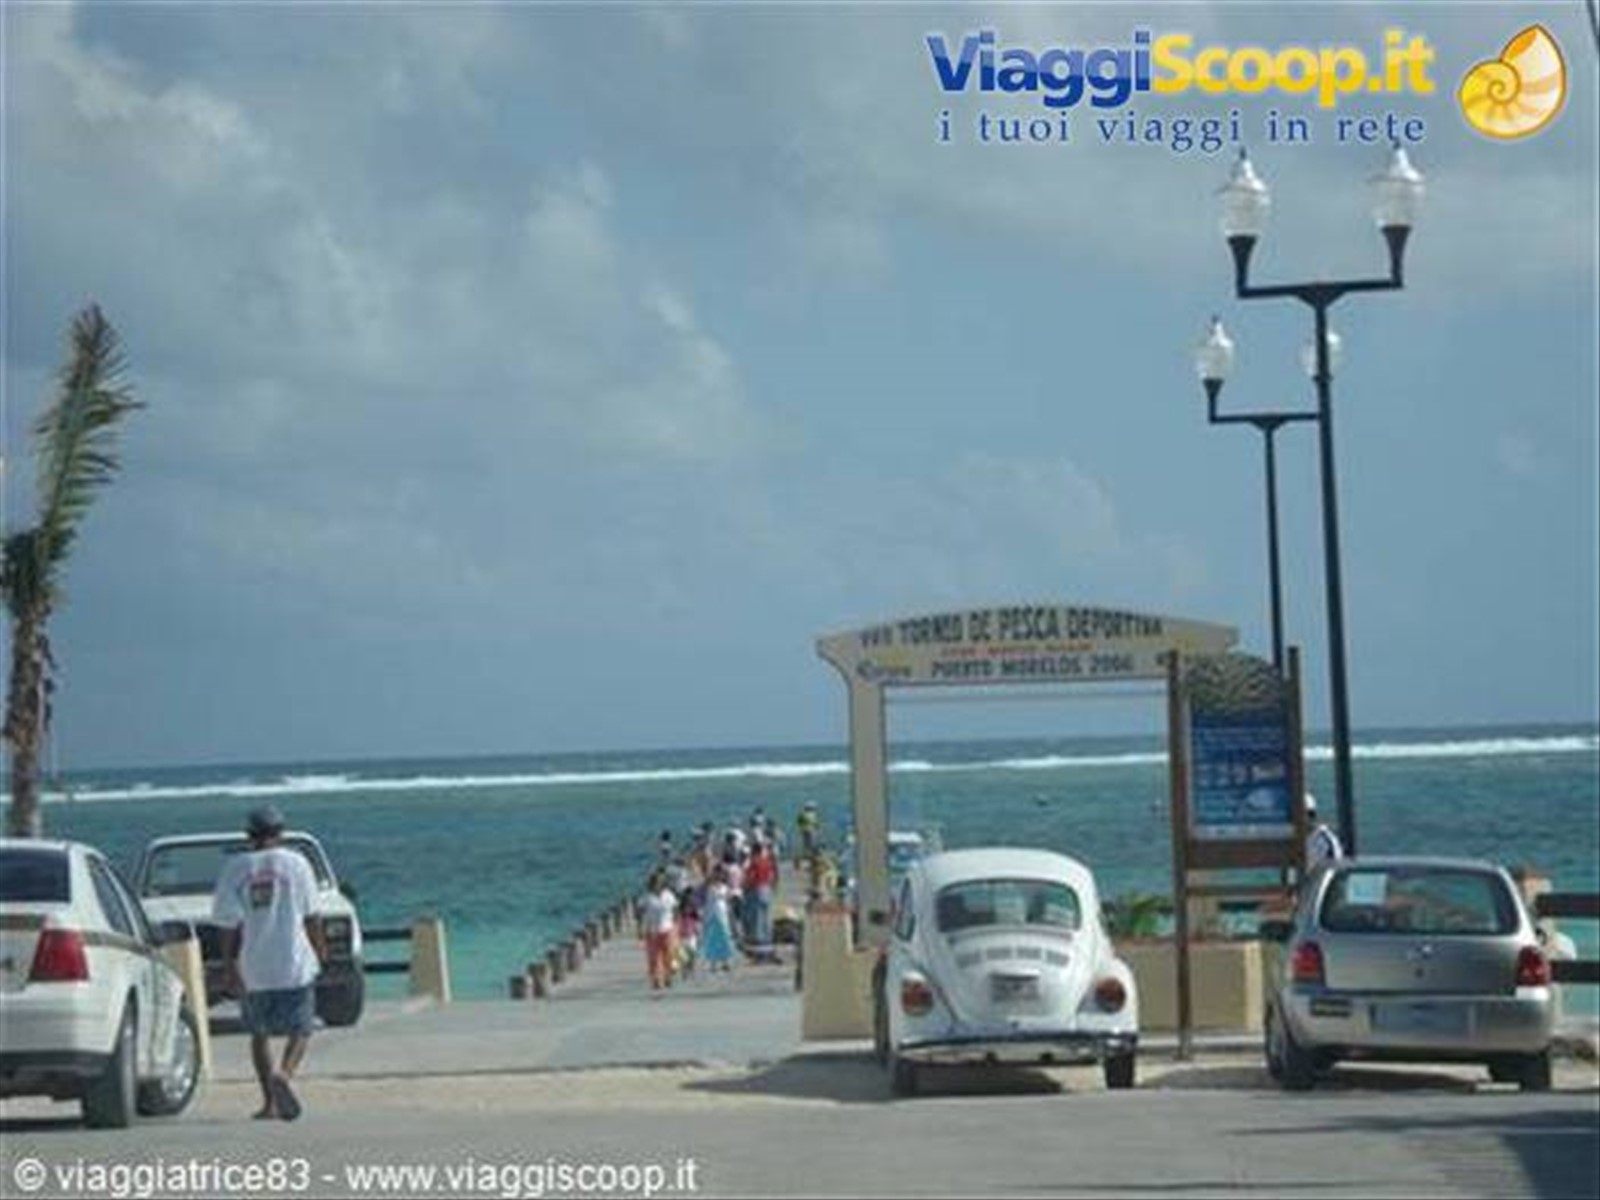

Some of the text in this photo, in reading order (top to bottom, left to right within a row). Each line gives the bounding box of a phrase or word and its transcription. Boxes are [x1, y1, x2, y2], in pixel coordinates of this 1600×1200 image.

[898, 612, 964, 645] TORNEO
[968, 607, 992, 641] DE
[998, 604, 1061, 642] PESCA
[1067, 607, 1163, 639] DEPORTIVA
[931, 659, 994, 679] PUERTO
[1001, 655, 1083, 677] MORELOS
